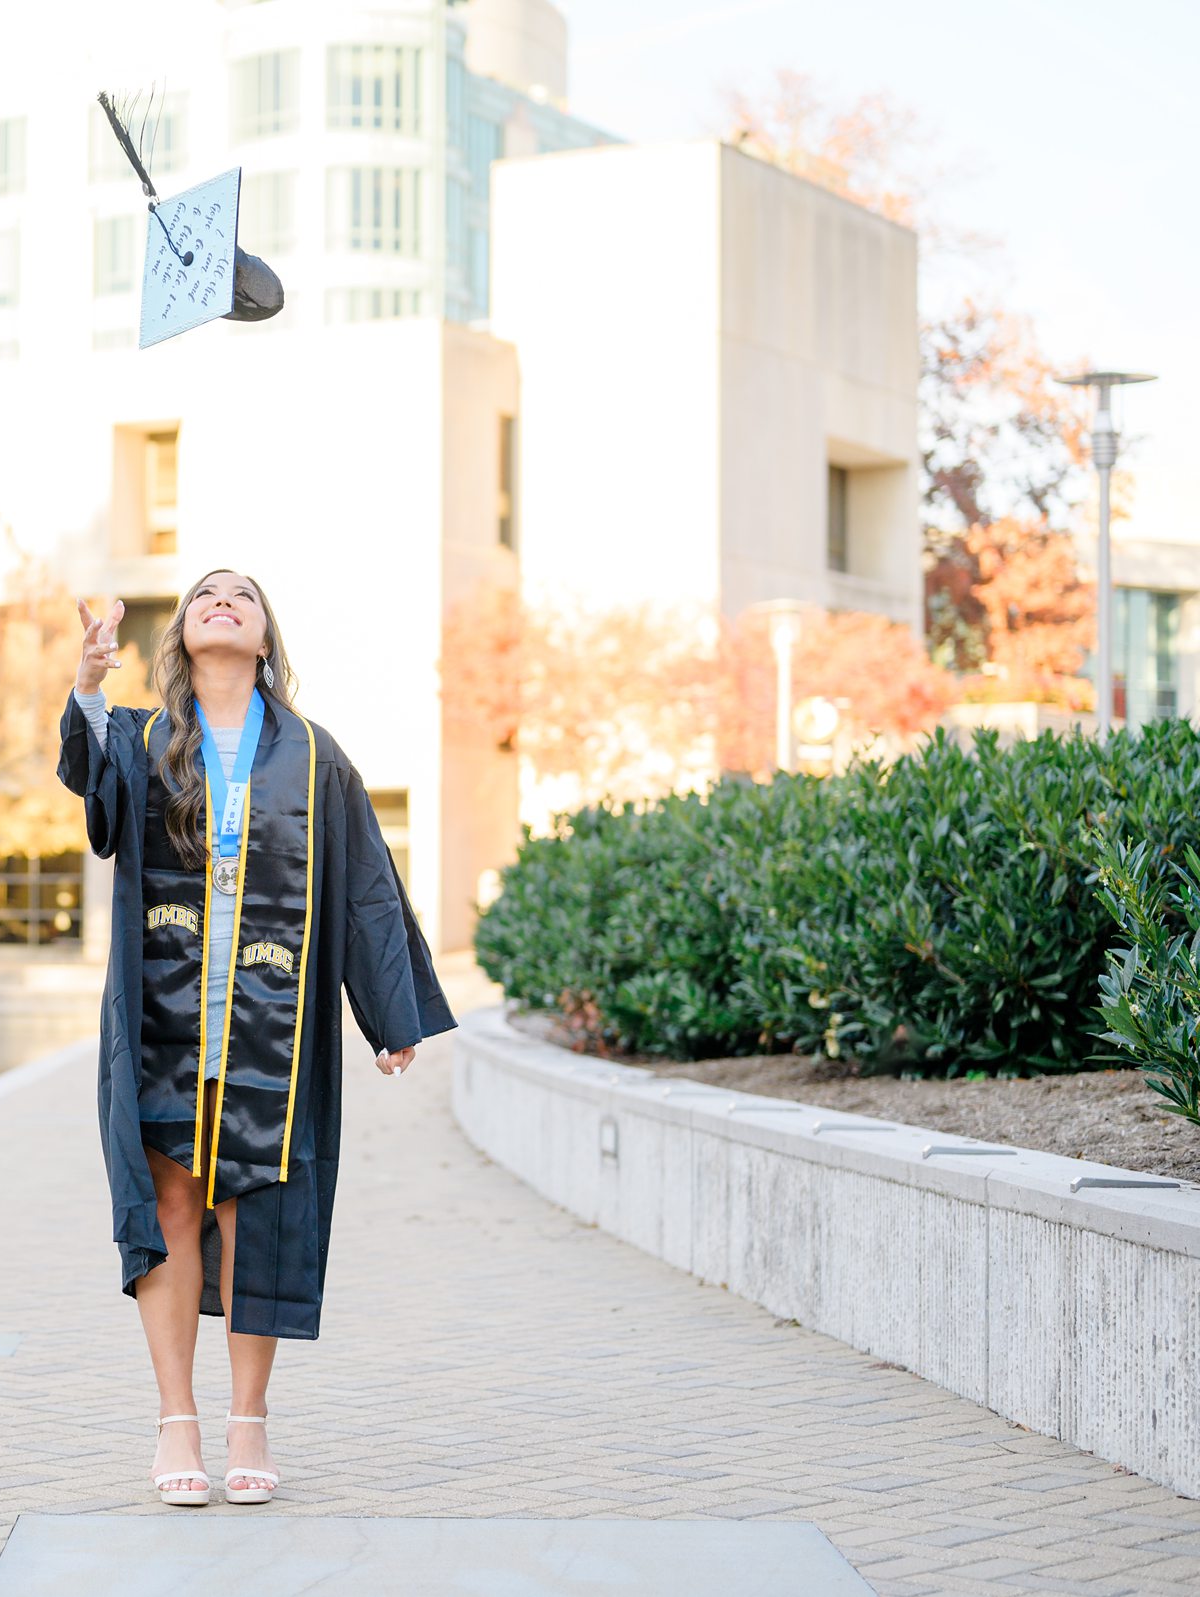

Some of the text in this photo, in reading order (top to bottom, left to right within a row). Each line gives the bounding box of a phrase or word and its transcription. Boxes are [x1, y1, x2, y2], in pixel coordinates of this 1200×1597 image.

[205, 202, 221, 230] hope
[160, 245, 167, 255] in
[196, 239, 204, 250] to
[152, 260, 161, 275] me
[162, 263, 172, 284] who
[201, 253, 212, 272] am
[188, 280, 200, 303] and
[201, 281, 216, 307] that
[147, 904, 198, 933] UMBC
[243, 942, 294, 973] UMBC
